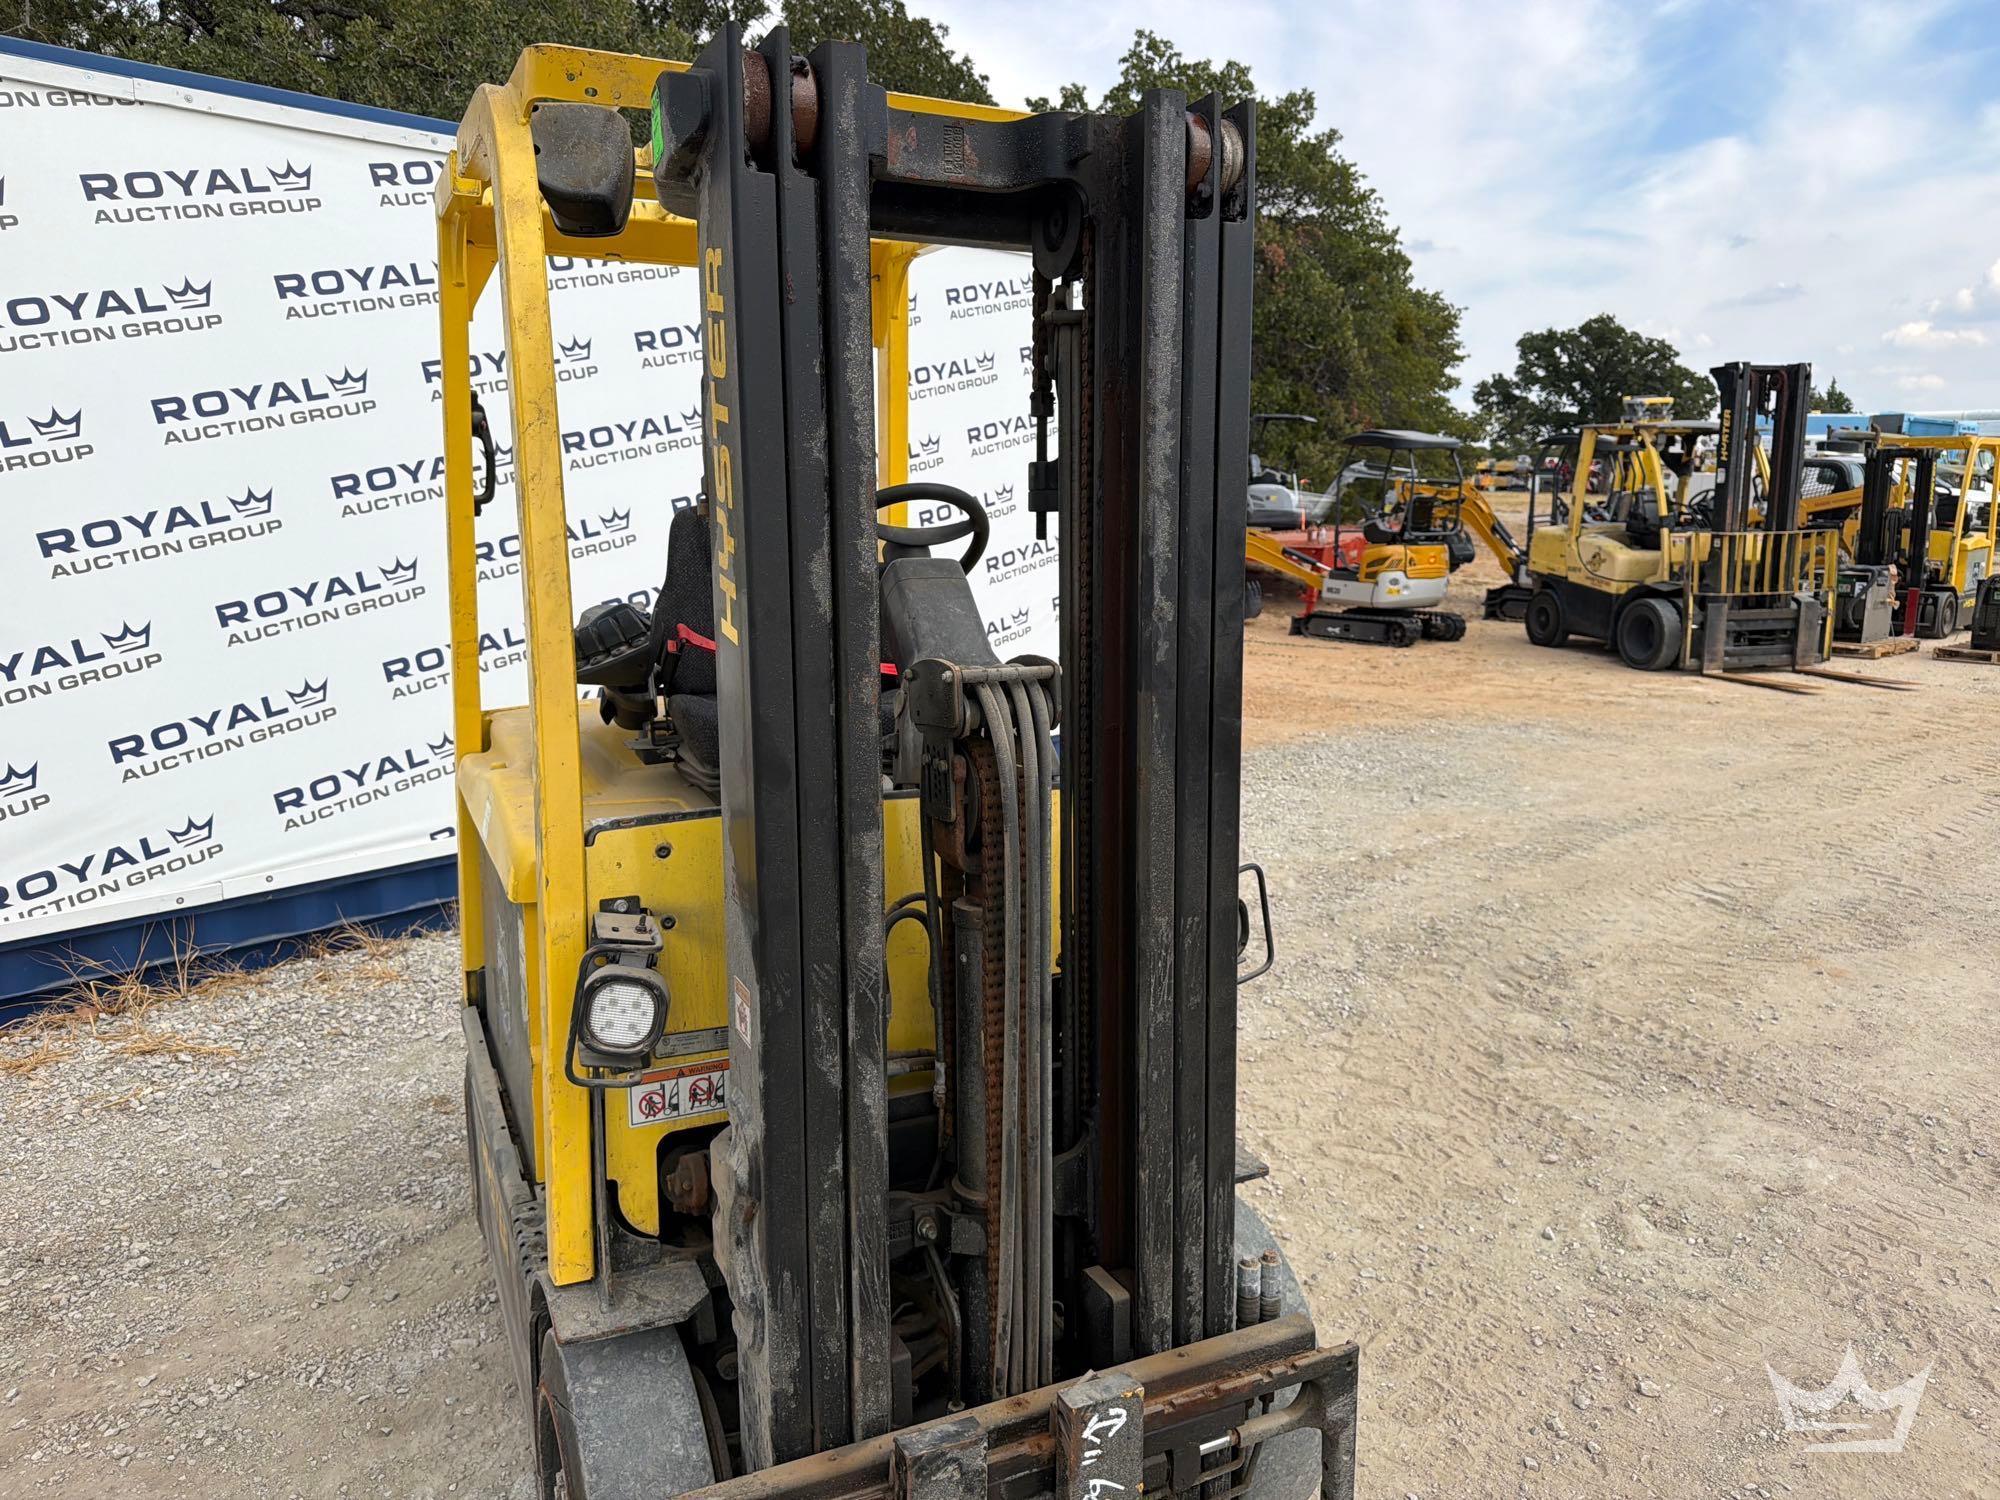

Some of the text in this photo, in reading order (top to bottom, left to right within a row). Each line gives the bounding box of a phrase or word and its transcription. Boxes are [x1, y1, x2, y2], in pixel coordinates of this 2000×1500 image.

[79, 168, 271, 201] ROYAL
[95, 198, 322, 224] AUCTION GROUP
[274, 263, 435, 299] ROYAL
[548, 266, 680, 290] CTION GROUP
[946, 279, 1021, 306] ROYAL
[0, 287, 167, 328] OYAL
[285, 297, 395, 320] AUCTION
[950, 298, 1033, 320] AUCTION GROU
[0, 314, 223, 352] UCTION GROUP
[634, 324, 702, 351] ROY
[555, 366, 599, 383] OUP
[641, 350, 703, 369] AUCTIO
[908, 358, 976, 387] OYAL
[151, 378, 329, 424] ROYAL
[909, 374, 998, 401] UCTION GROUP
[164, 400, 377, 446] AUCTION GROUP
[562, 415, 682, 453] ROYAL
[967, 414, 1037, 445] ROYAL
[569, 434, 703, 471] AUCTION GROU
[705, 247, 739, 647] HYSTER
[970, 437, 1021, 458] AUCTION
[331, 456, 444, 499] ROYA
[909, 457, 944, 474] ROUP
[341, 486, 444, 518] AUCTION
[987, 504, 1017, 520] ROUP
[36, 501, 231, 558] ROYAL
[51, 519, 283, 579] AUCTION GROUP
[572, 534, 637, 559] GROUP
[986, 540, 1055, 573] ROYAL
[989, 554, 1059, 585] AUCTION GRO
[215, 571, 381, 628] ROYAL
[227, 586, 426, 647] AUCTION GROUP
[994, 626, 1032, 647] GROUP
[0, 639, 105, 682] YAL
[58, 653, 163, 690] GROUP
[108, 696, 289, 764] ROYAL
[121, 707, 337, 783] AUCTION GROUP
[273, 749, 430, 815] ROYAL
[284, 763, 456, 832] AUCTION GROU
[3, 843, 224, 921] CTION GROUP
[688, 1062, 724, 1075] WARNING
